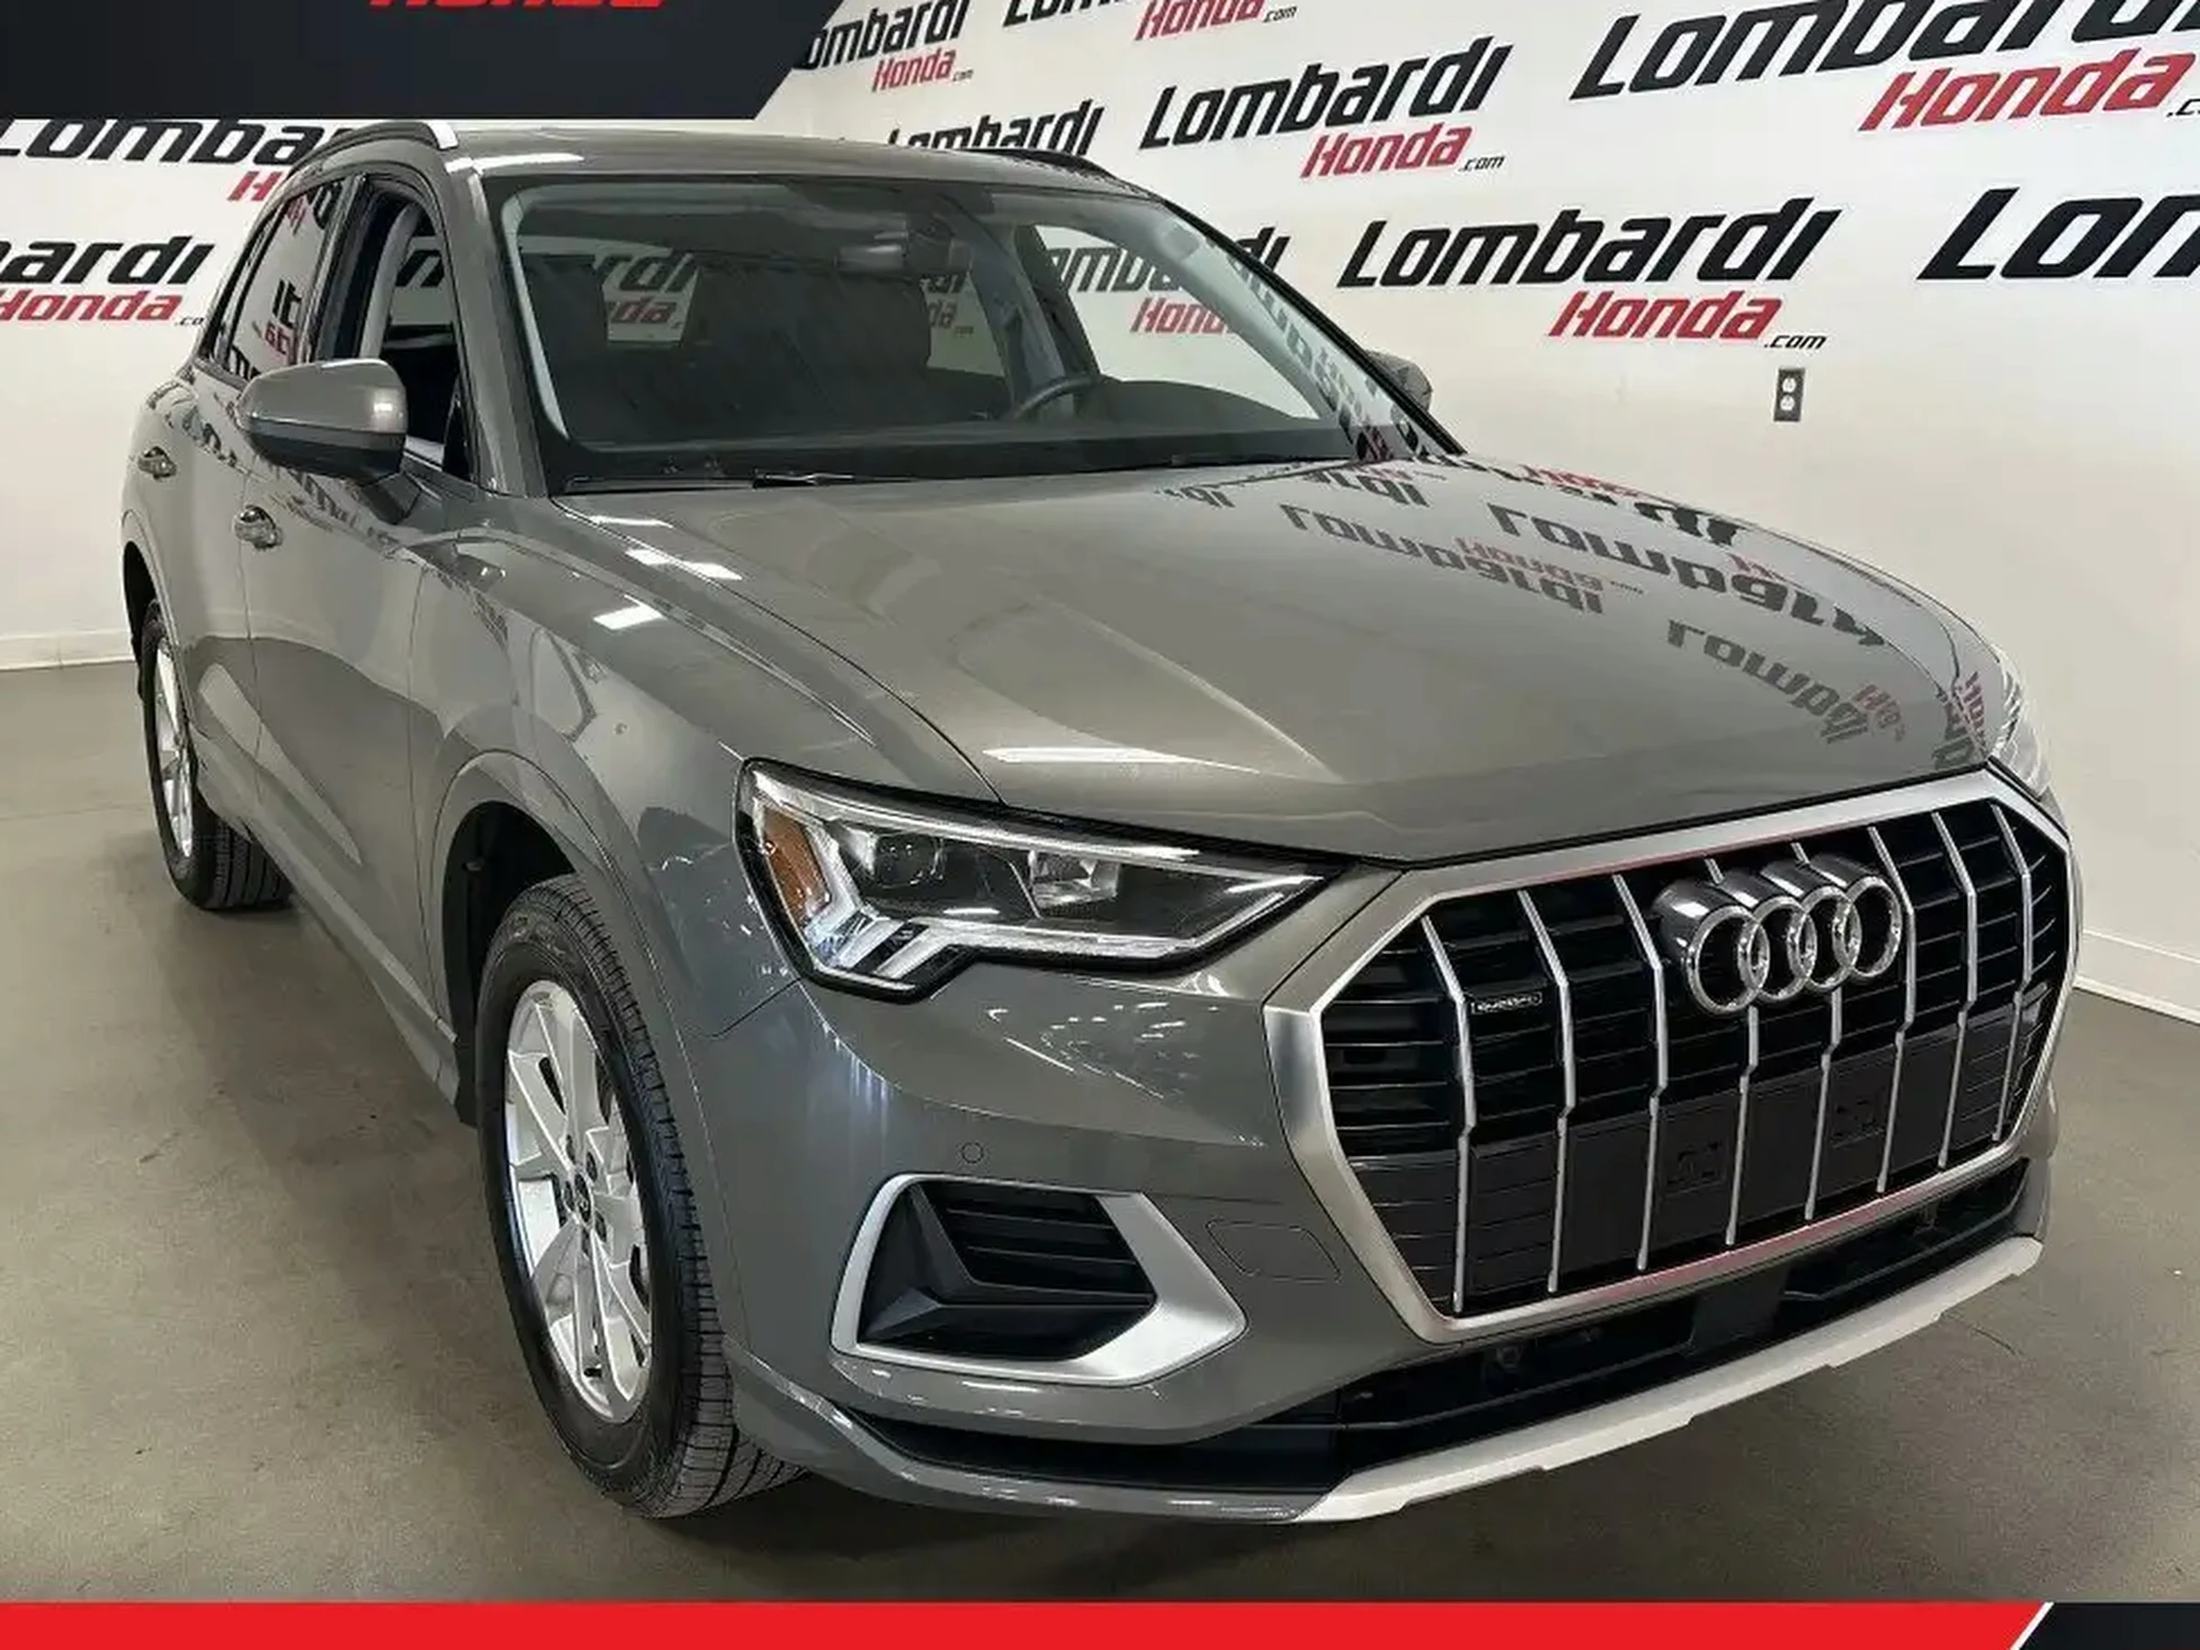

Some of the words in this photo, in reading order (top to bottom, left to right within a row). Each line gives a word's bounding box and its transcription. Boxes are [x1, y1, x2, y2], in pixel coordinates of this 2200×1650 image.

[791, 0, 970, 70] ombardi
[872, 48, 957, 93] Honda
[1570, 0, 2200, 100] Lombar
[1139, 35, 1514, 149] Lombardi
[1859, 48, 2197, 132] Honda
[1300, 122, 1473, 178] Honda
[1457, 155, 1506, 172] .com
[1337, 197, 1842, 288] Lombardi
[1549, 290, 1782, 339] Honda
[1763, 334, 1827, 349] .com
